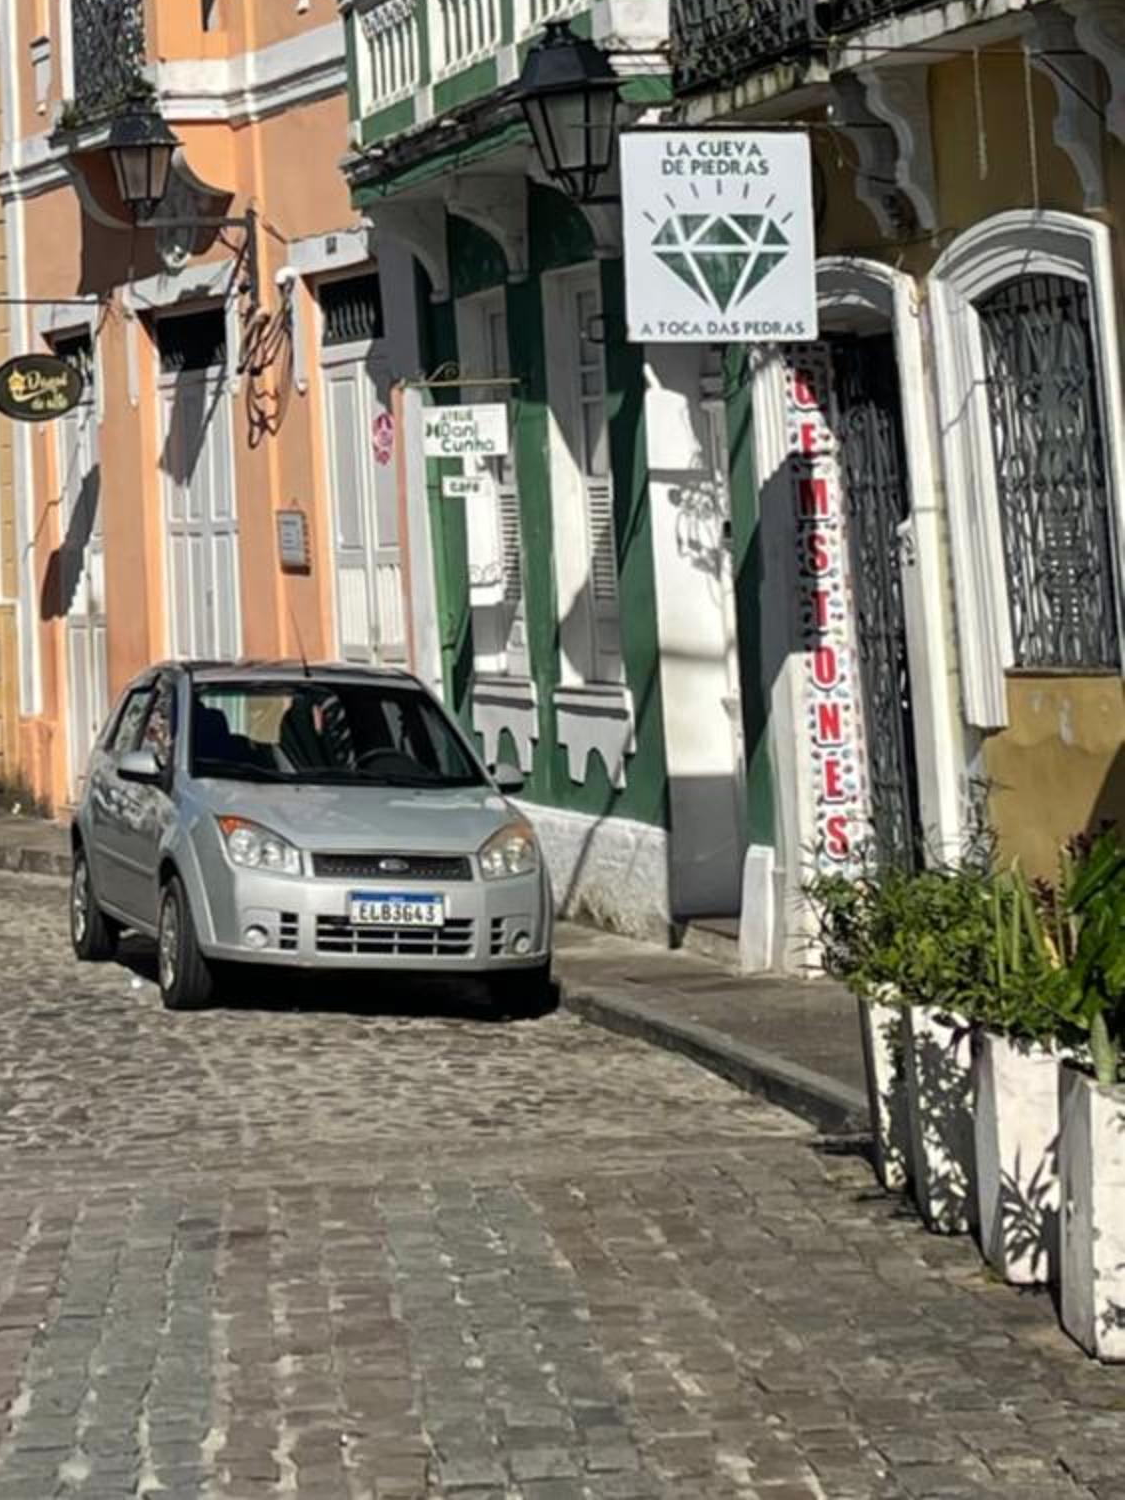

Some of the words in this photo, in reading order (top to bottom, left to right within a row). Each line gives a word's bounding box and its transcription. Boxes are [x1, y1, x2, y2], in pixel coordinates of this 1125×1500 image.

[666, 141, 692, 157] LA
[697, 141, 762, 157] CUEVA
[661, 159, 684, 176] DE
[690, 159, 769, 176] PIEDRAS
[641, 323, 652, 335] A
[658, 322, 702, 335] TOCA
[707, 321, 740, 335] DAS
[744, 321, 805, 335] PEDRAS
[441, 436, 495, 453] Cunha
[793, 370, 850, 861] GEMSTONES
